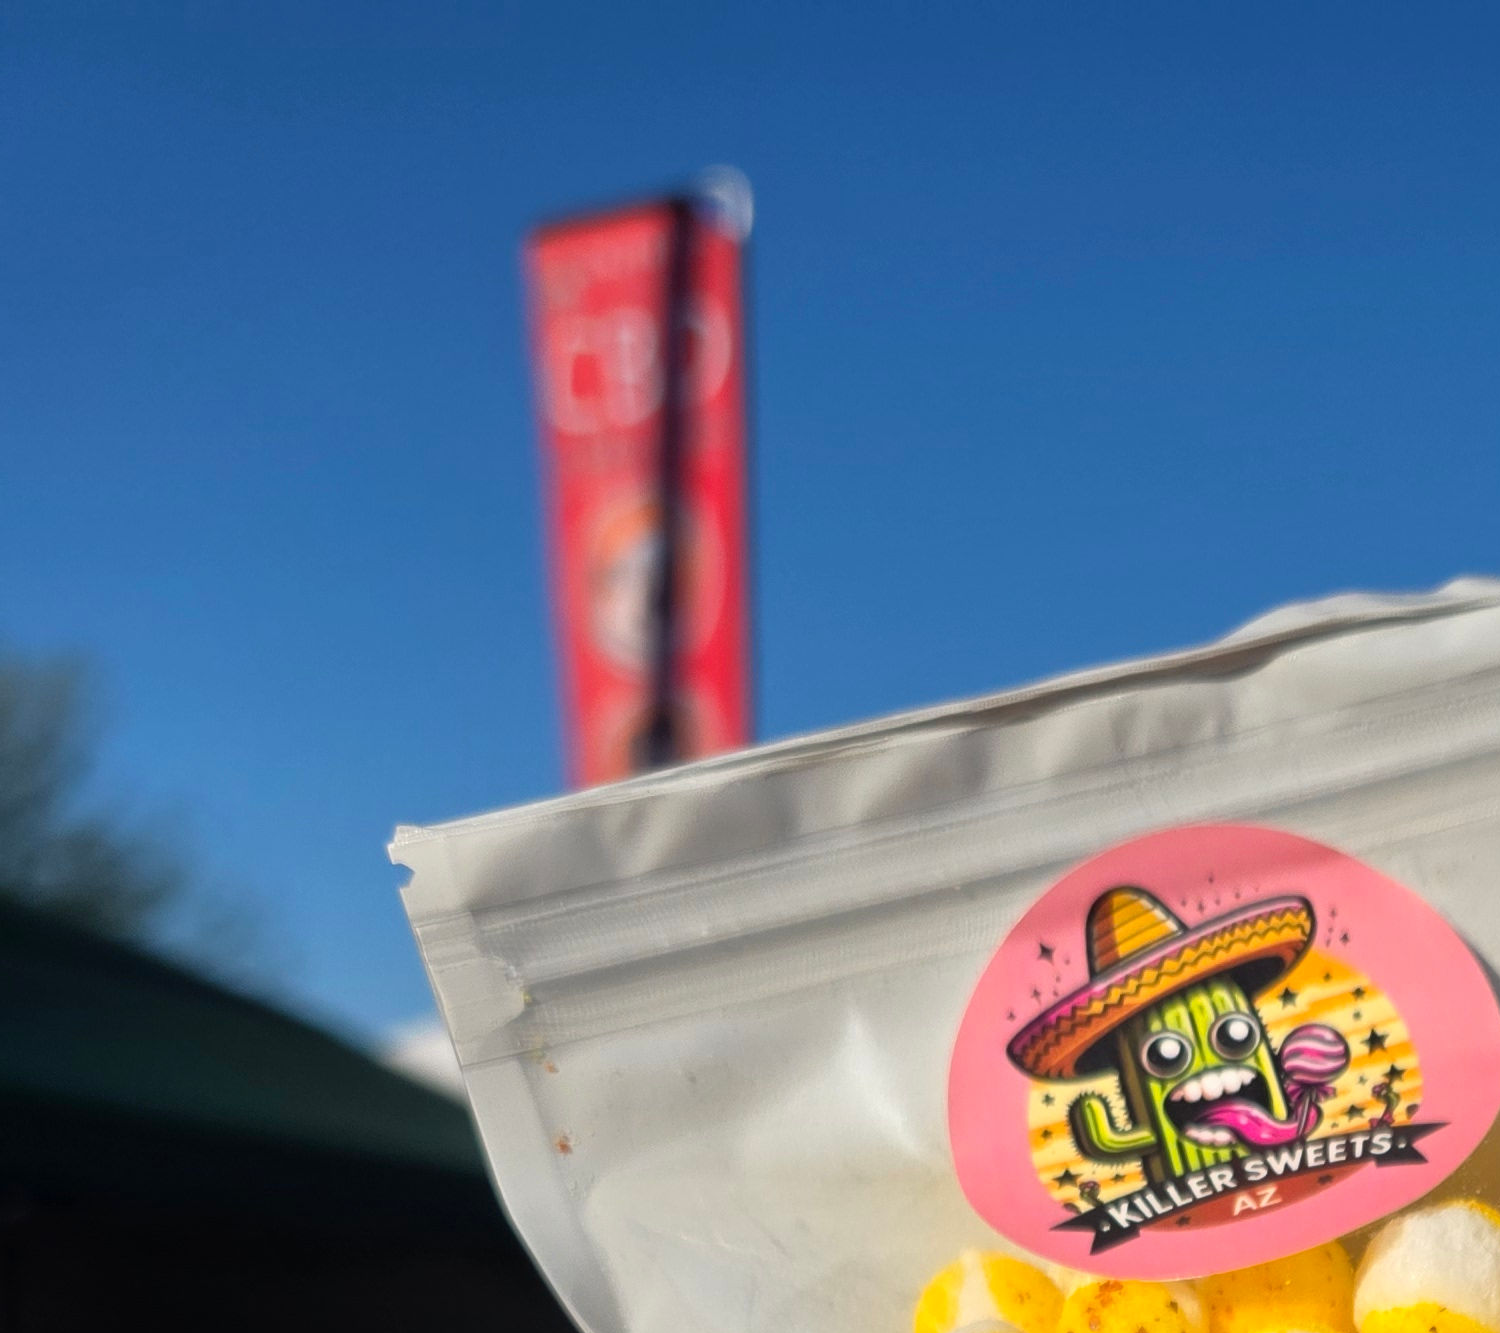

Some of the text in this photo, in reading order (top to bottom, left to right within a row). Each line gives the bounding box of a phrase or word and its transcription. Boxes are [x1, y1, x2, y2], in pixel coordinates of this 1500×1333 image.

[1109, 1131, 1393, 1229] KILLER SWEETS
[1233, 1187, 1283, 1217] AZ
